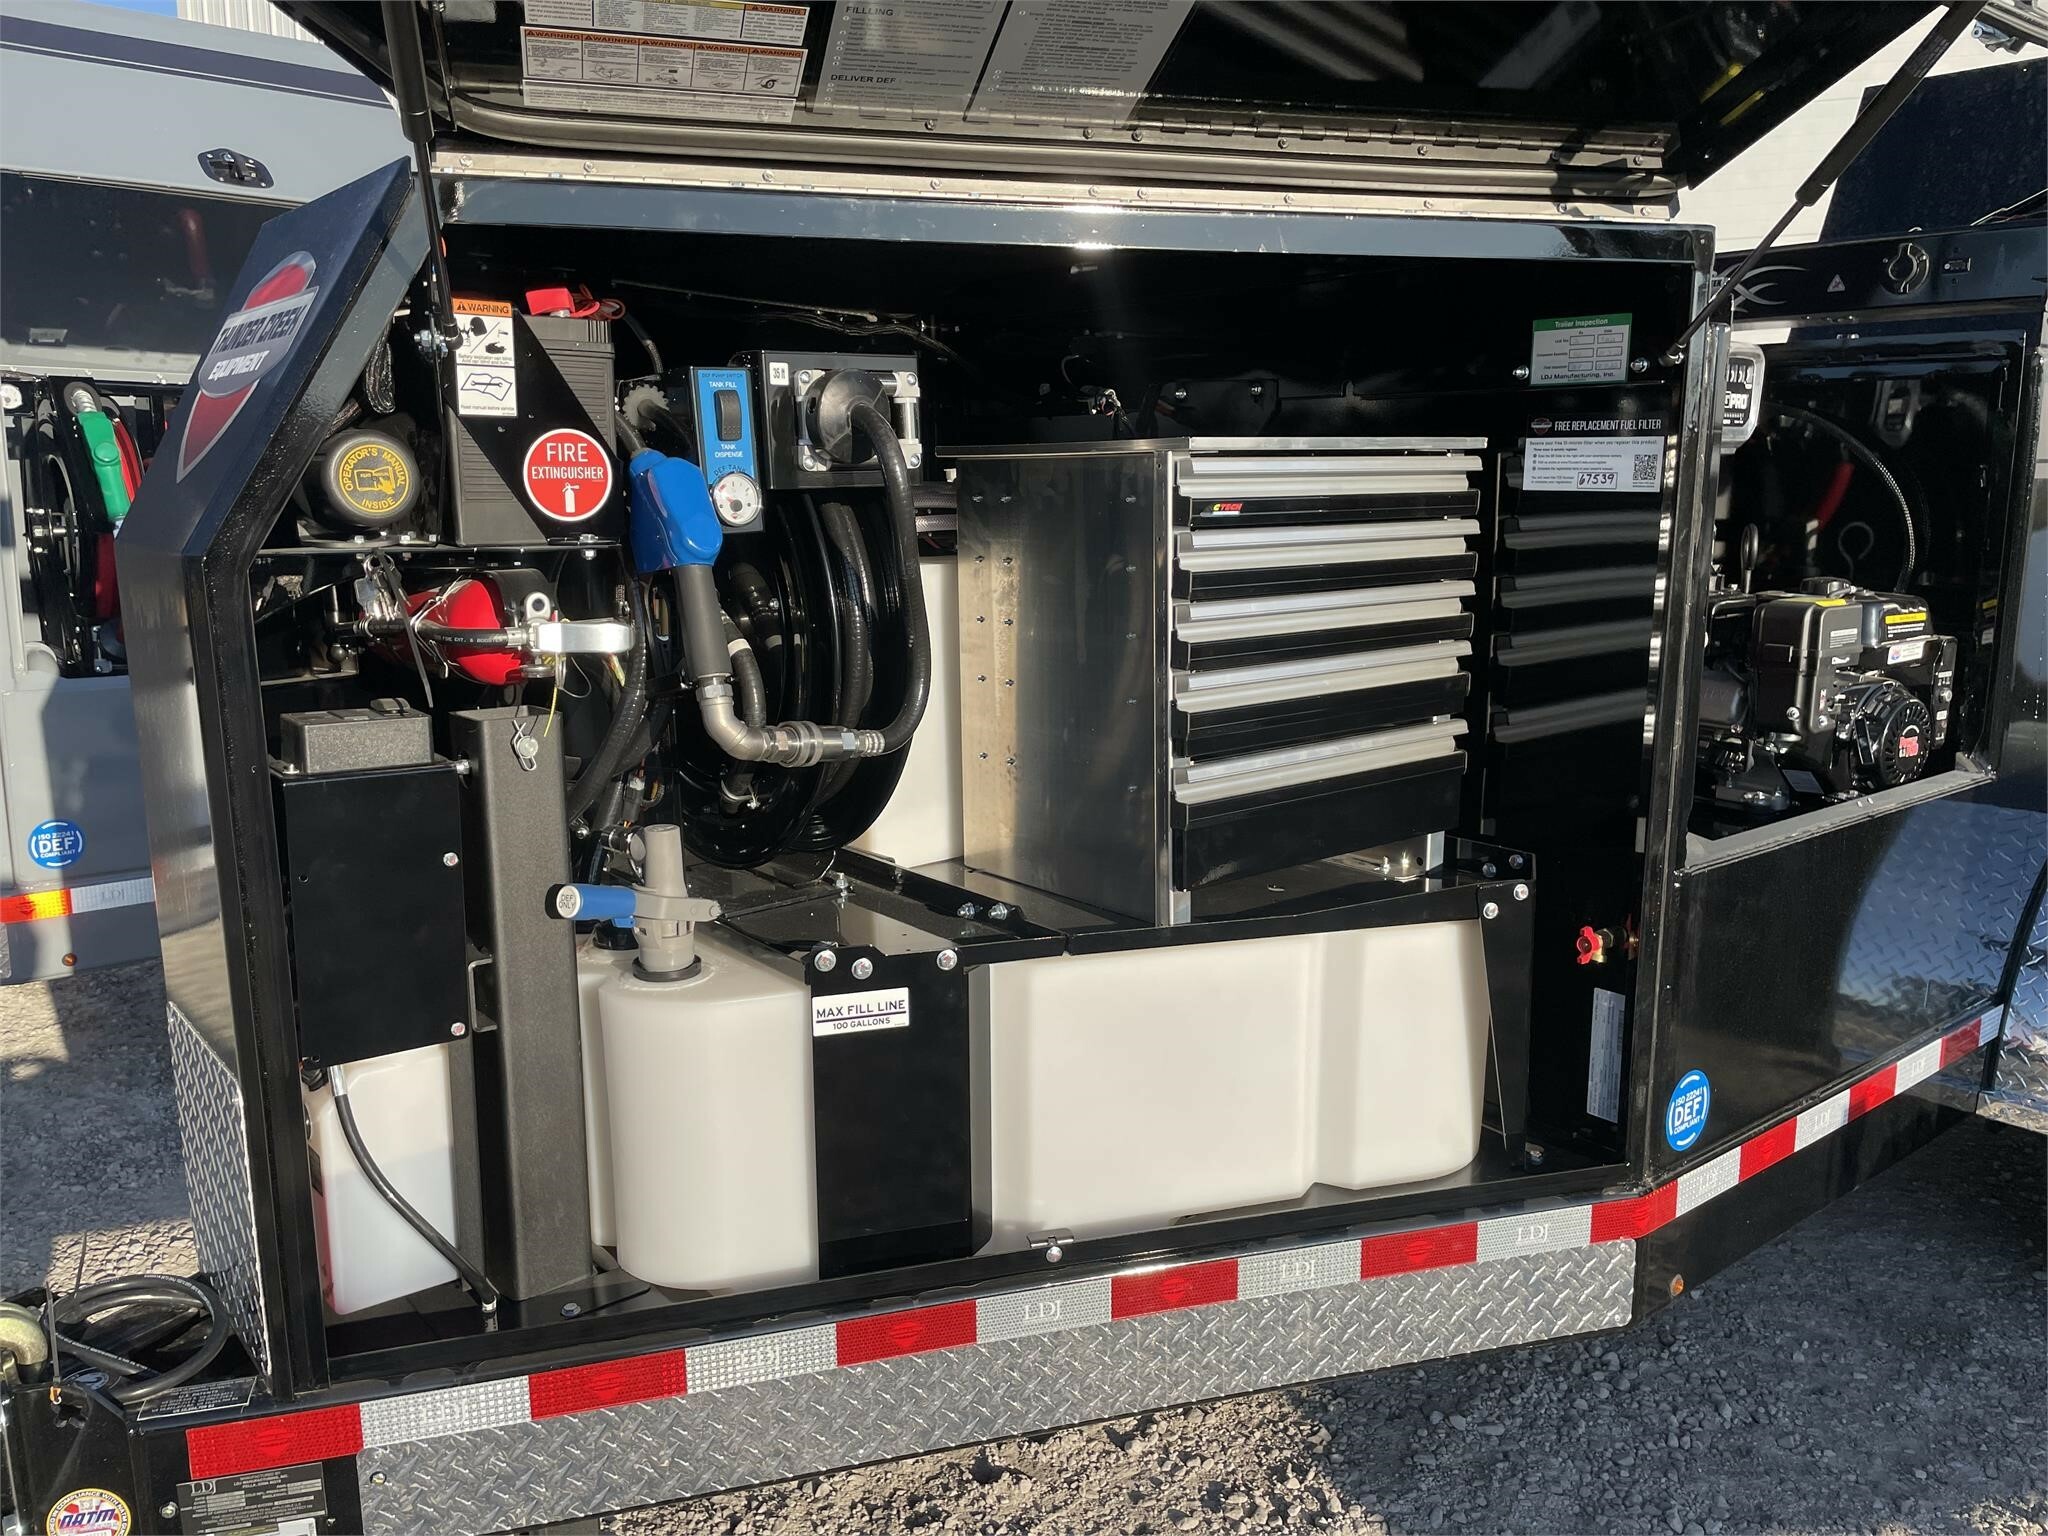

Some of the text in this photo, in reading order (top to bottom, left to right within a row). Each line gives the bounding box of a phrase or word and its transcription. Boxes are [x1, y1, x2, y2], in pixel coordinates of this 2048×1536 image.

[758, 6, 804, 15] WARNING
[536, 31, 580, 39] WARNING
[592, 35, 637, 43] WARNING
[650, 40, 693, 49] WARNING
[705, 45, 747, 53] WARNING
[757, 49, 801, 57] WARNING
[467, 302, 510, 314] WARNING
[212, 305, 308, 354] THUNDER CREEK
[1575, 319, 1608, 328] Inspection
[208, 350, 270, 381] EQUIPMENT
[1554, 419, 1662, 431] FREE REPLACEMENT FUEL FILTER
[546, 442, 589, 462] FIRE
[343, 447, 405, 491] OPERATOR'S MANUAL
[531, 466, 604, 480] EXTINGUISHER
[1579, 473, 1615, 486] 67539
[361, 497, 396, 509] INSIDE
[51, 831, 74, 839] 22241
[39, 837, 74, 854] DEF
[40, 850, 76, 859] COMPLIANT
[559, 900, 577, 909] ONLY
[816, 1000, 906, 1019] MAX FILL LINE
[833, 1017, 891, 1030] 100 GALLONS
[1675, 1087, 1703, 1107] ISO 22241
[1674, 1096, 1702, 1127] DEF
[1674, 1115, 1701, 1135] COMPLIANT
[1517, 1223, 1549, 1242] LDJ
[1024, 1300, 1061, 1321] LDJ
[190, 1479, 217, 1495] LDJ
[58, 1491, 101, 1511] COMPLIANCE
